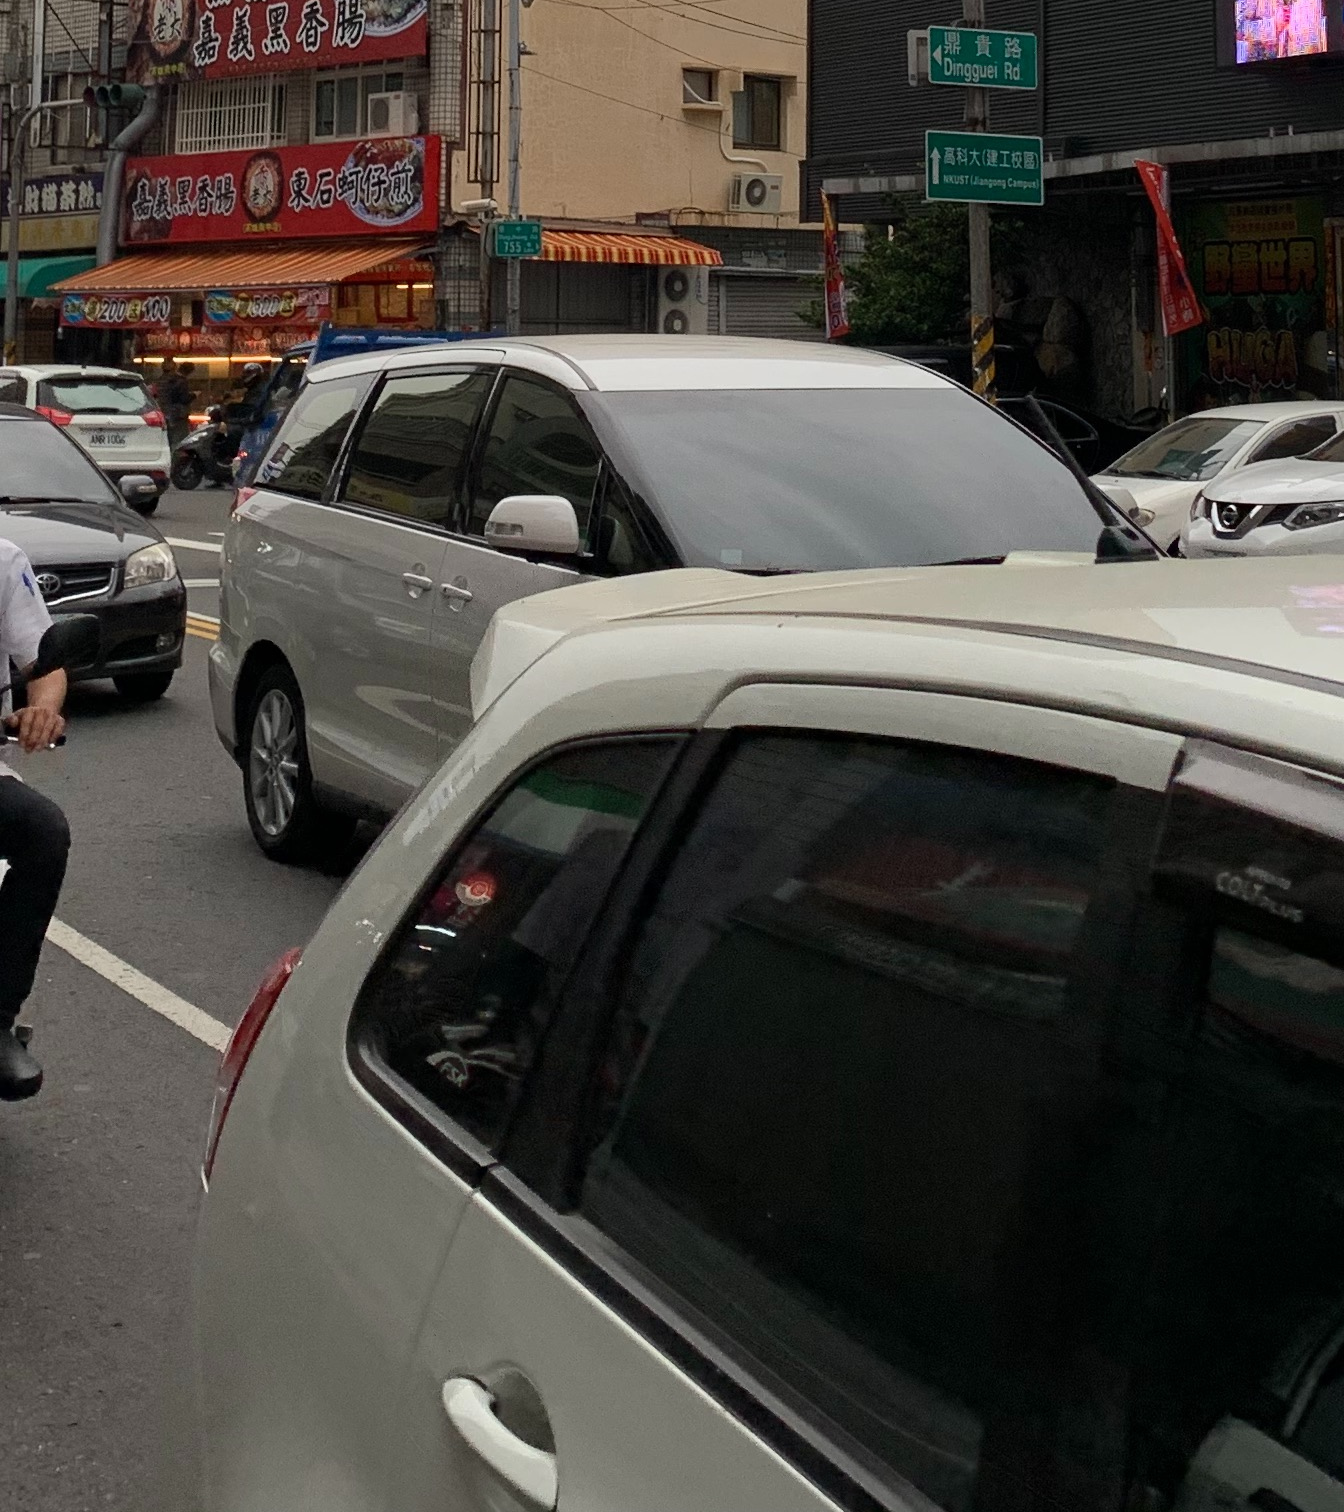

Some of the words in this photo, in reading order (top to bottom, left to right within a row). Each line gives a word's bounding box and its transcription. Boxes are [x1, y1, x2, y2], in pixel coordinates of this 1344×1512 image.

[944, 31, 1022, 59] 鼎貴路
[944, 57, 998, 82] Dingguei
[132, 172, 236, 222] 嘉義黑香腸
[287, 161, 415, 213] 東石蚵仔煎
[503, 241, 522, 253] 755
